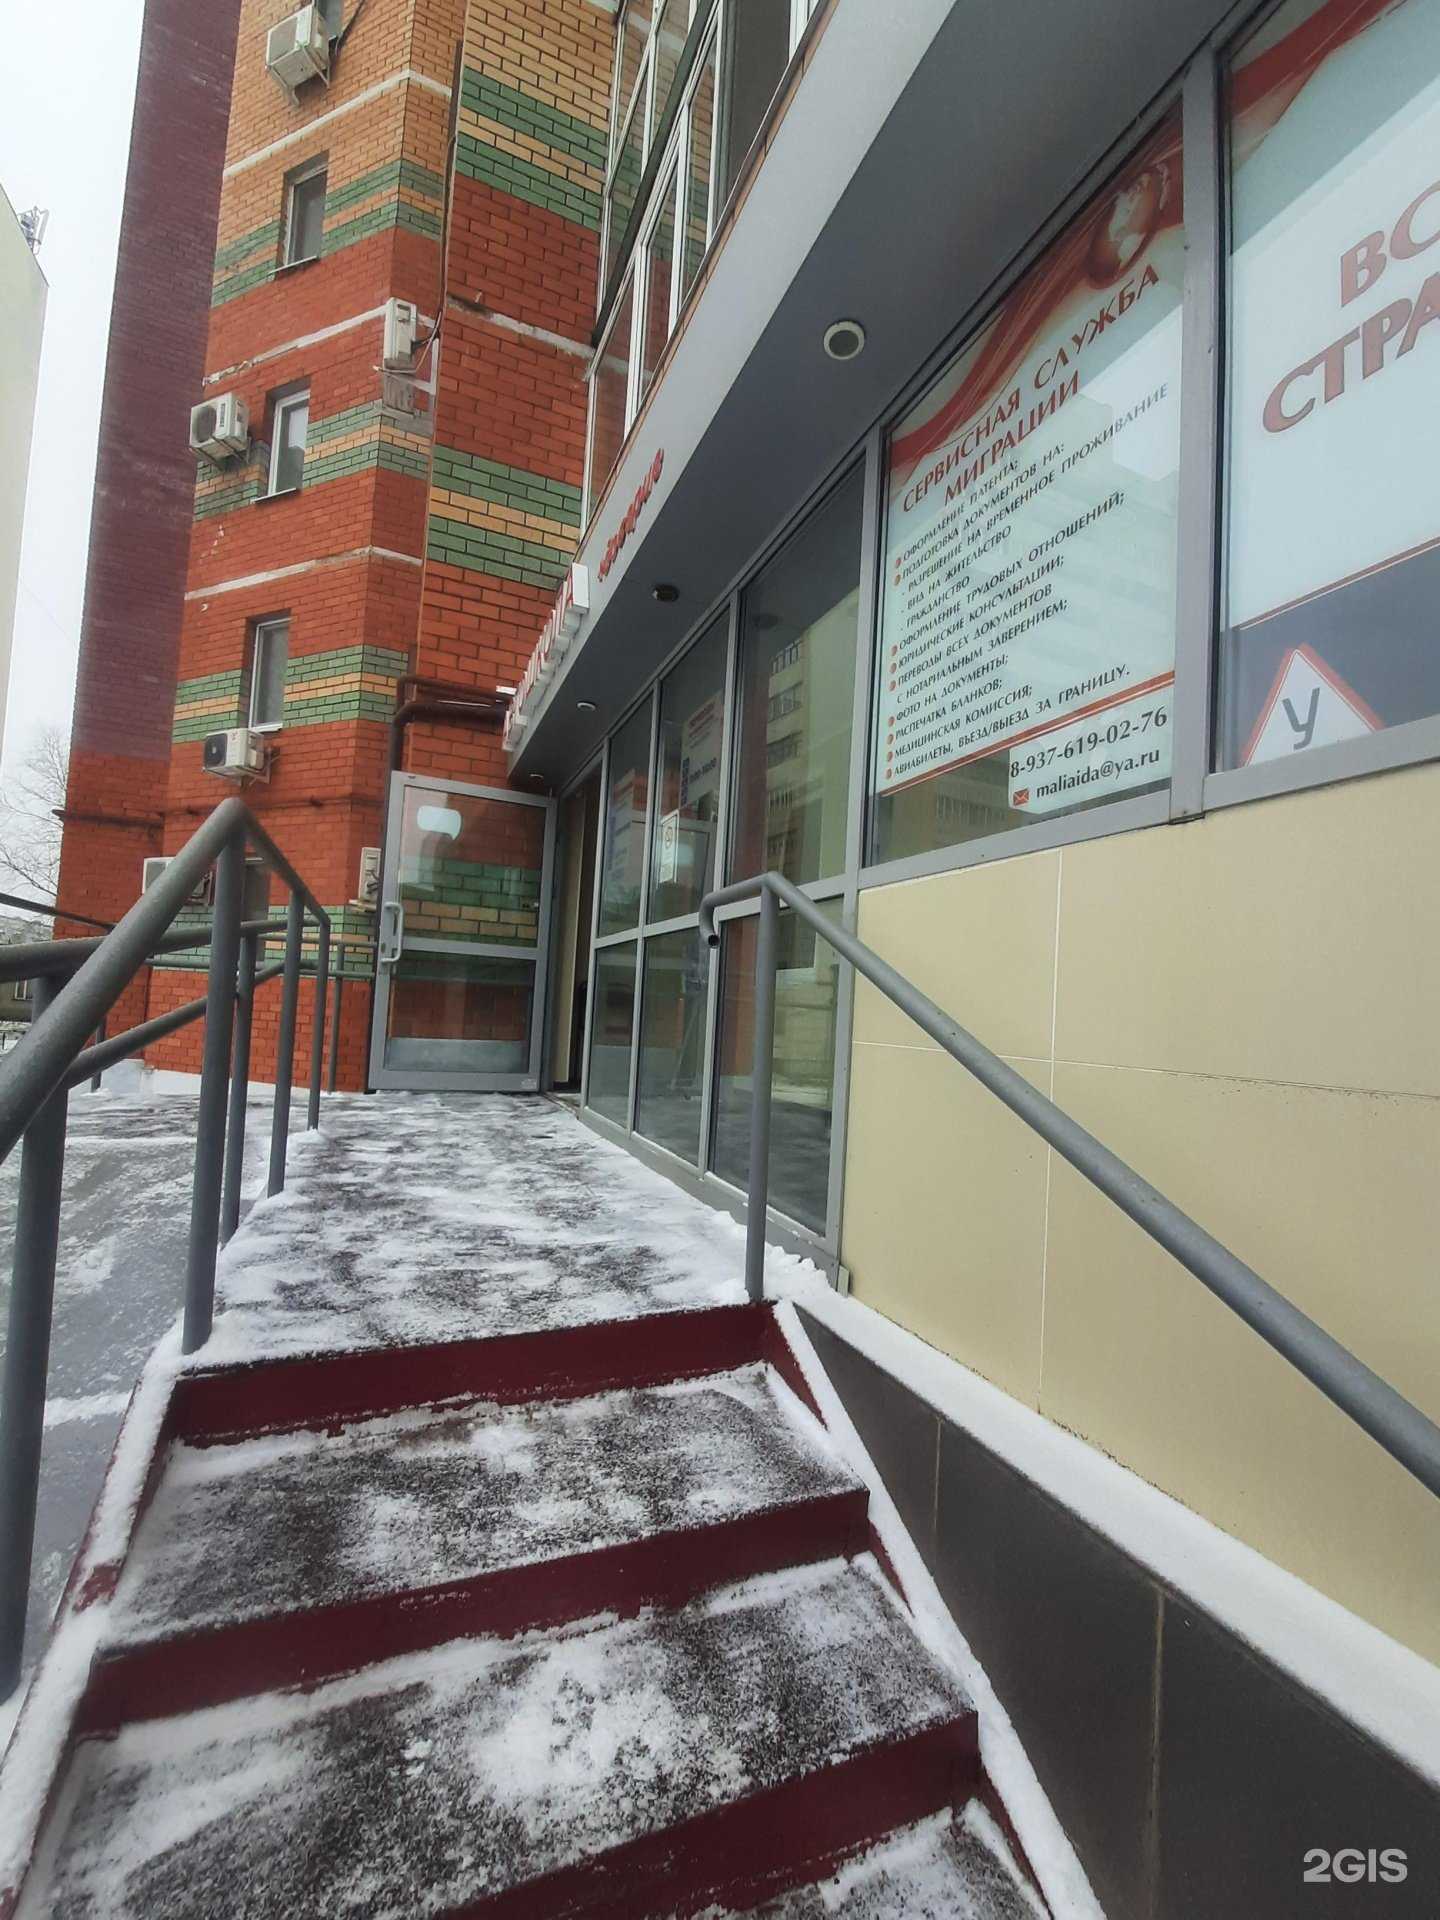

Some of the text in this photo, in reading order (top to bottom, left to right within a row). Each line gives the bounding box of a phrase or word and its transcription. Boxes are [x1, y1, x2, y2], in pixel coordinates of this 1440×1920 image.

[903, 264, 1159, 512] СЕРВИСНАЯ СЛУЖБА
[945, 370, 1078, 506] МИГРАЦИИ
[902, 443, 1064, 579] ПОДГОТОВКА ДОКУМЕНТОВ НА:
[903, 460, 1018, 561] ОФОРМЛЕНИЕ ПАТЕНТА;
[908, 383, 1168, 592] РАЗРЕШЕНИЕ НА ВРЕМЕННОЕ ПРОЖИВАНИЕ
[899, 490, 1125, 650] ОФОРМЛЕНИЕ ТРУДОВЫХ ОТНОШЕНИЙ;
[899, 555, 1064, 669] ЮРИДИЧЕСКИЕ КОНСУЛЬТАЦИИ;
[906, 575, 970, 628] ГРАЖДАНСТВО
[907, 525, 1011, 610] ВИД НА ЖИТЕЛЬСТВО
[898, 584, 1052, 686] ПЕРЕВОДЫ ВСЕХ ДОКУМЕНТОВ
[906, 647, 982, 699] НОТАРИАЛЬНЫМ
[988, 599, 1067, 651] ЗАВЕРЕНИЕМ;
[894, 664, 1130, 775] АВИАБИЛЕТЫ, ВЪЕЗД/ВЫЕЗД ЗА ГРАНИЦУ.
[894, 684, 1032, 759] МЕДИЦИНСКАЯ КОМИССИЯ;
[895, 678, 1002, 740] РАСПЕЧАТКА БЛАНКОВ;
[896, 654, 1008, 721] ФОТО НА ДОКУМЕНТЫ;
[1011, 705, 1167, 778] 8-937-619-02-76
[1036, 749, 1160, 798] maliaida@ya.ru
